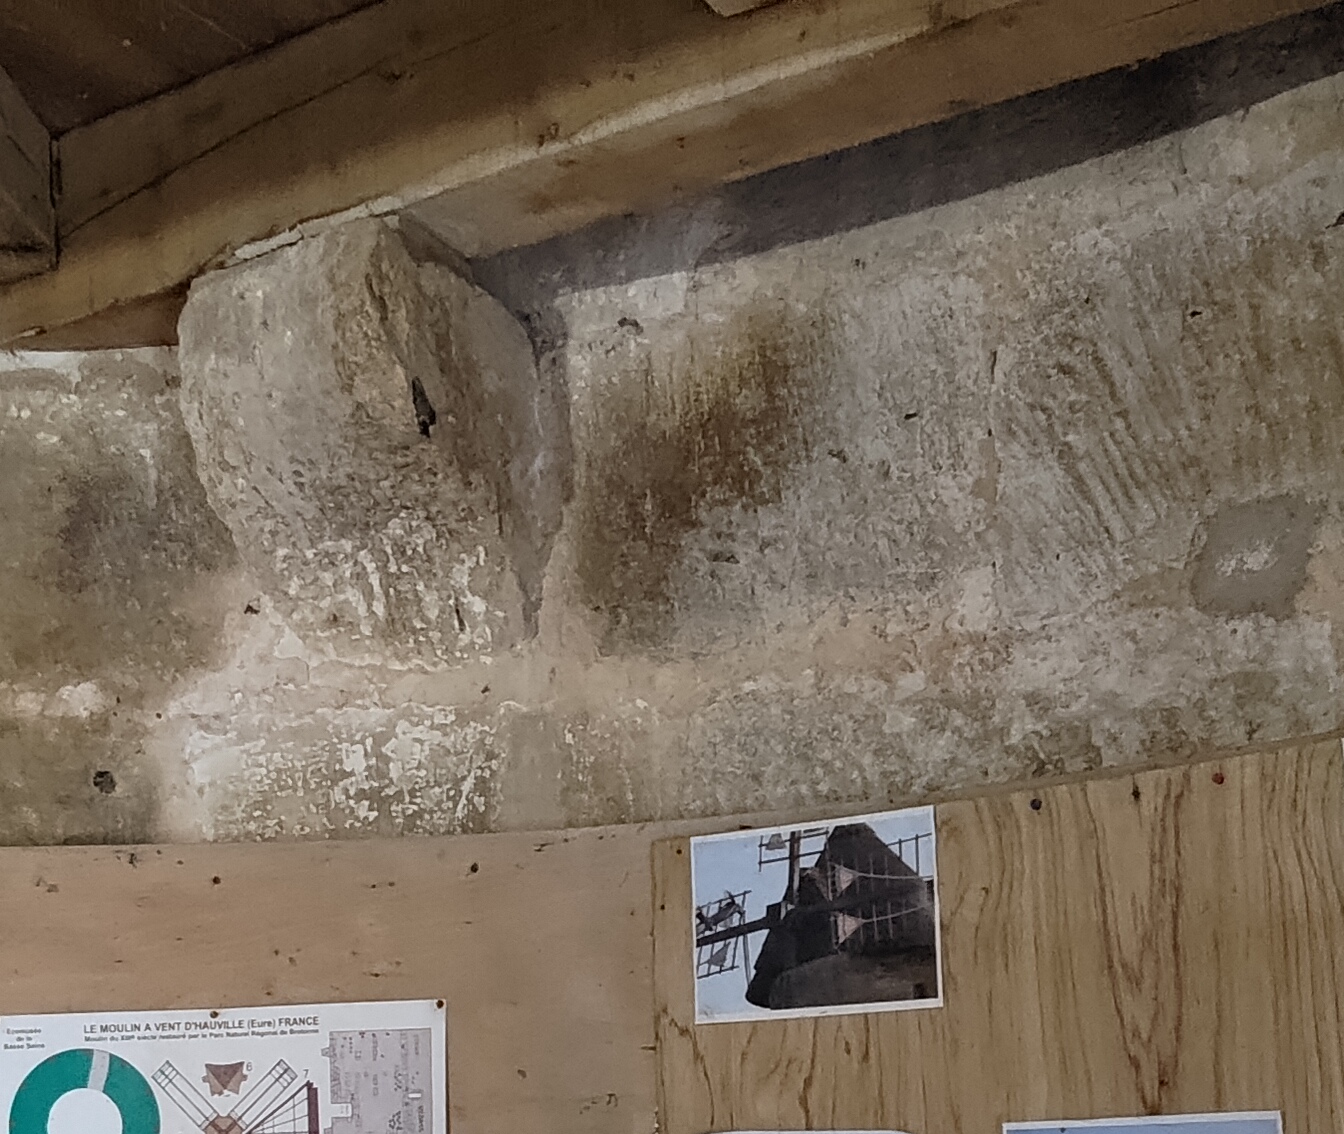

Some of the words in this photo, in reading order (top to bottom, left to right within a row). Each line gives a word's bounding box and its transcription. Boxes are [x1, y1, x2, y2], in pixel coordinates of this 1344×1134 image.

[83, 1024, 96, 1033] LE
[100, 1022, 140, 1033] MOULIN
[144, 1022, 151, 1031] A
[154, 1021, 180, 1031] VENT
[184, 1019, 244, 1030] D'HAUVILLE
[247, 1018, 275, 1030] (Eure)
[278, 1016, 318, 1027] FRANCE
